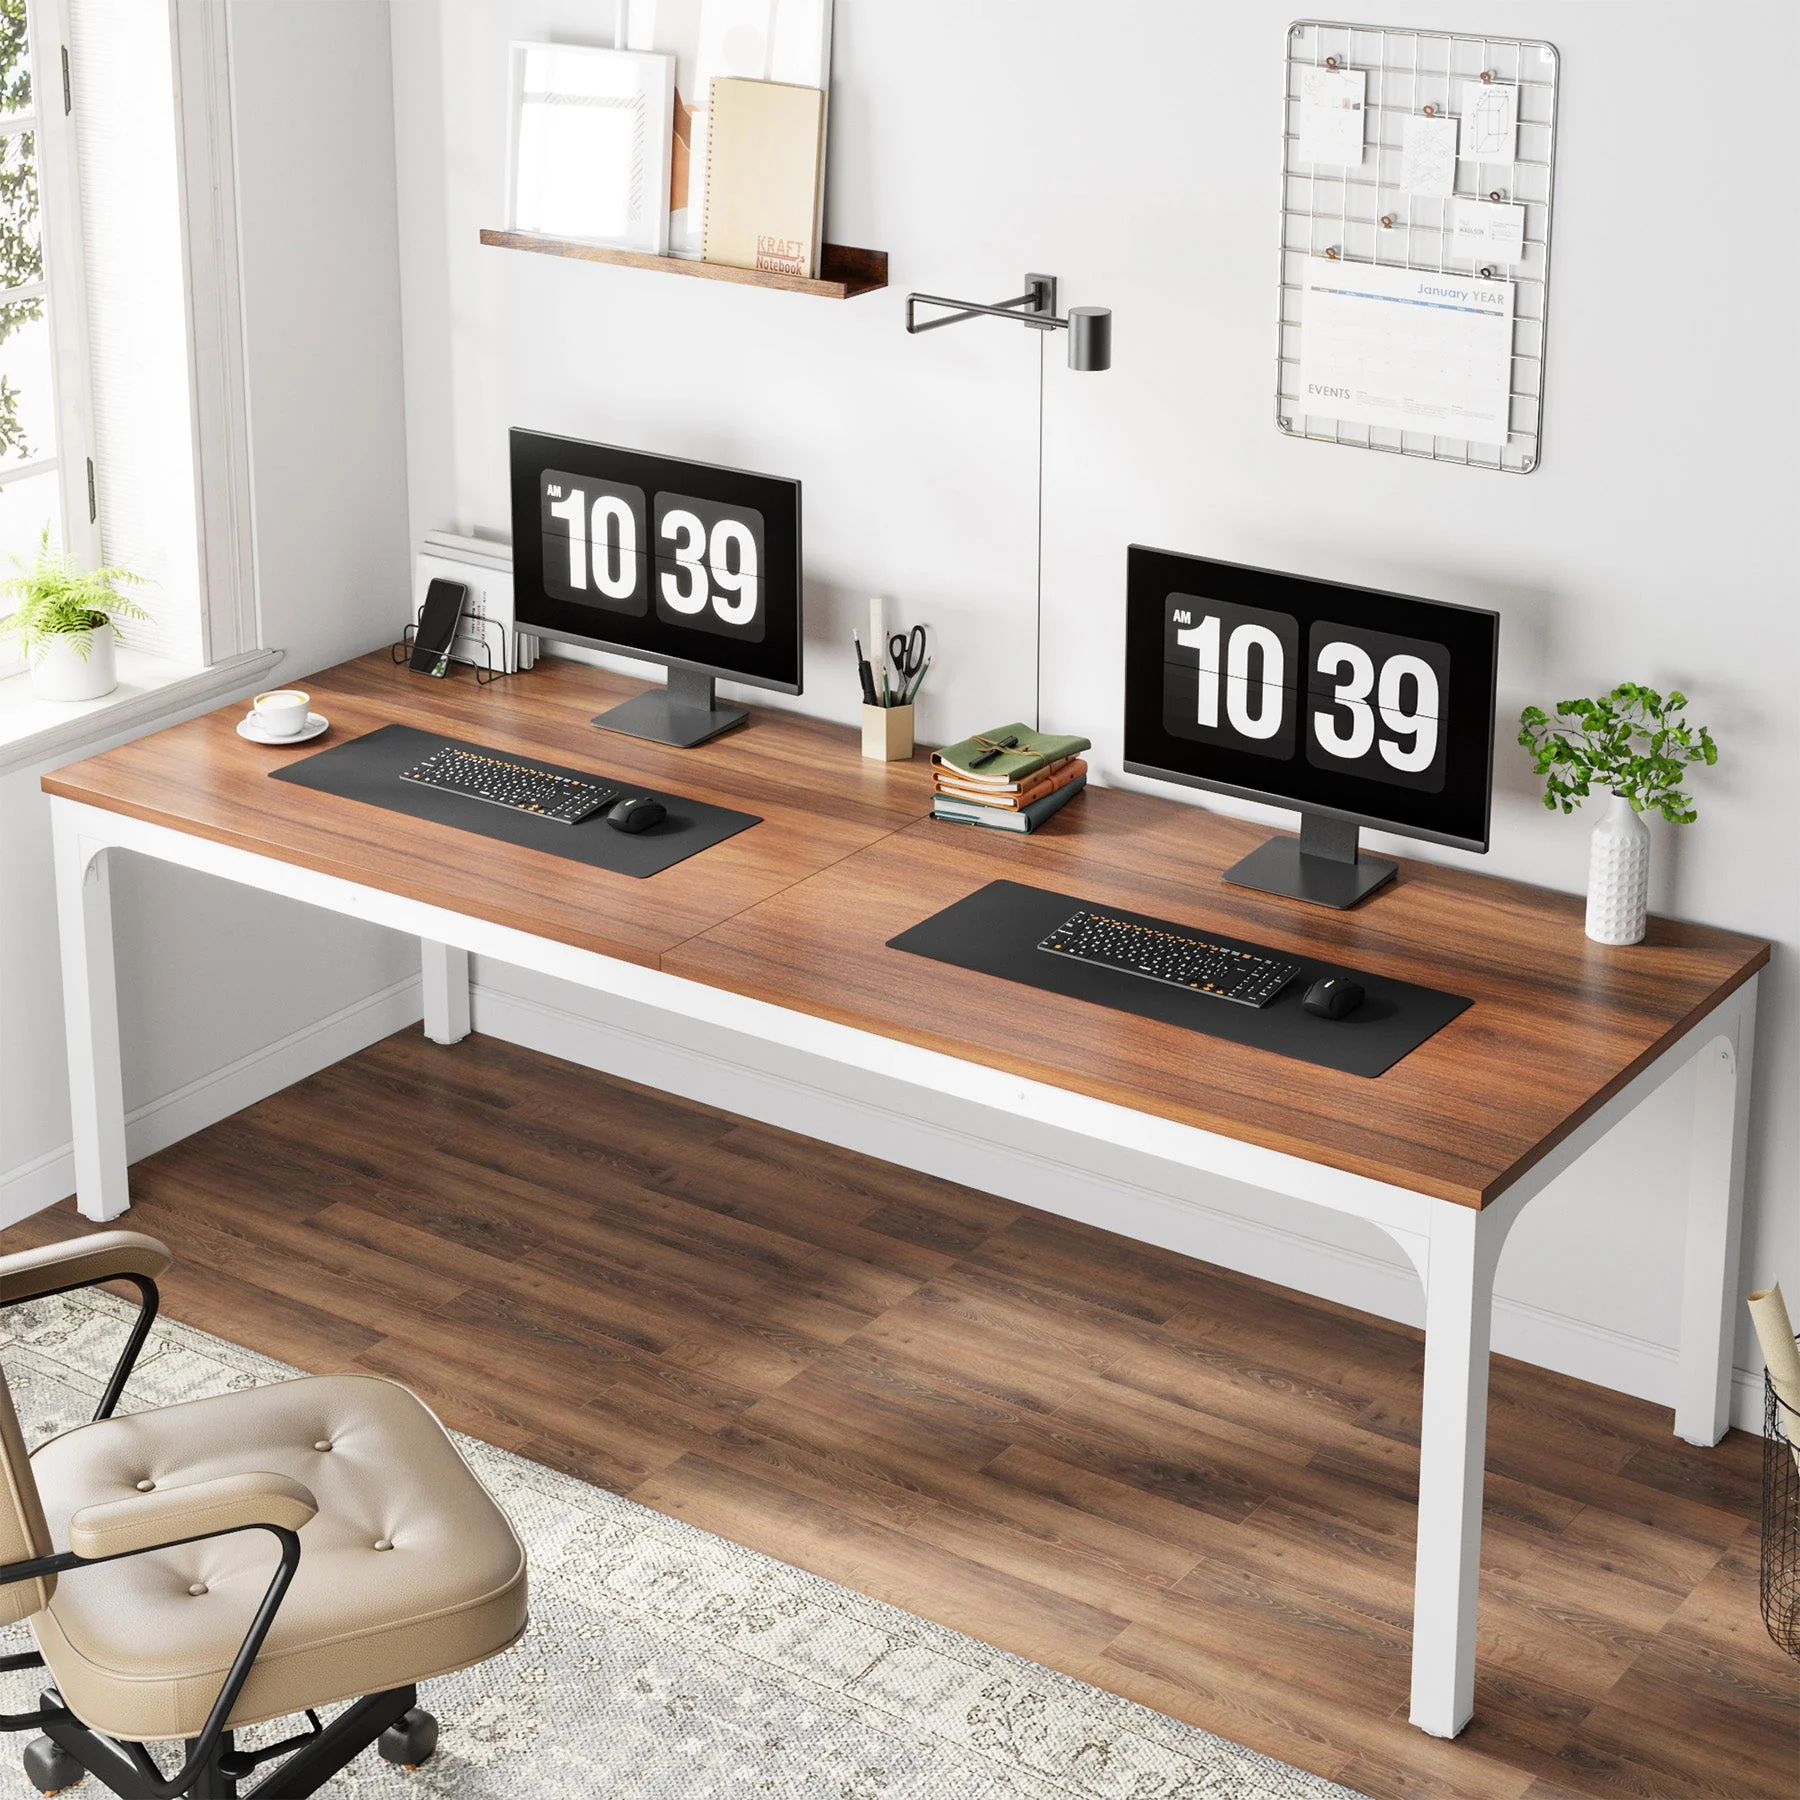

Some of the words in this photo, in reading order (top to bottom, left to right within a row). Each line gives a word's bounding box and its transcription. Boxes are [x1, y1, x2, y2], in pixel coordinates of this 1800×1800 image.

[757, 235, 803, 259] KRAFT
[756, 255, 802, 275] Notebook
[1417, 283, 1468, 301] January
[1472, 290, 1504, 305] YEAR
[1308, 384, 1350, 400] EVENTS
[546, 483, 562, 498] AM
[551, 489, 637, 599] 10
[660, 509, 758, 625] 39
[1173, 608, 1192, 625] AM
[1177, 615, 1284, 740] 10
[1314, 641, 1439, 773] 39
